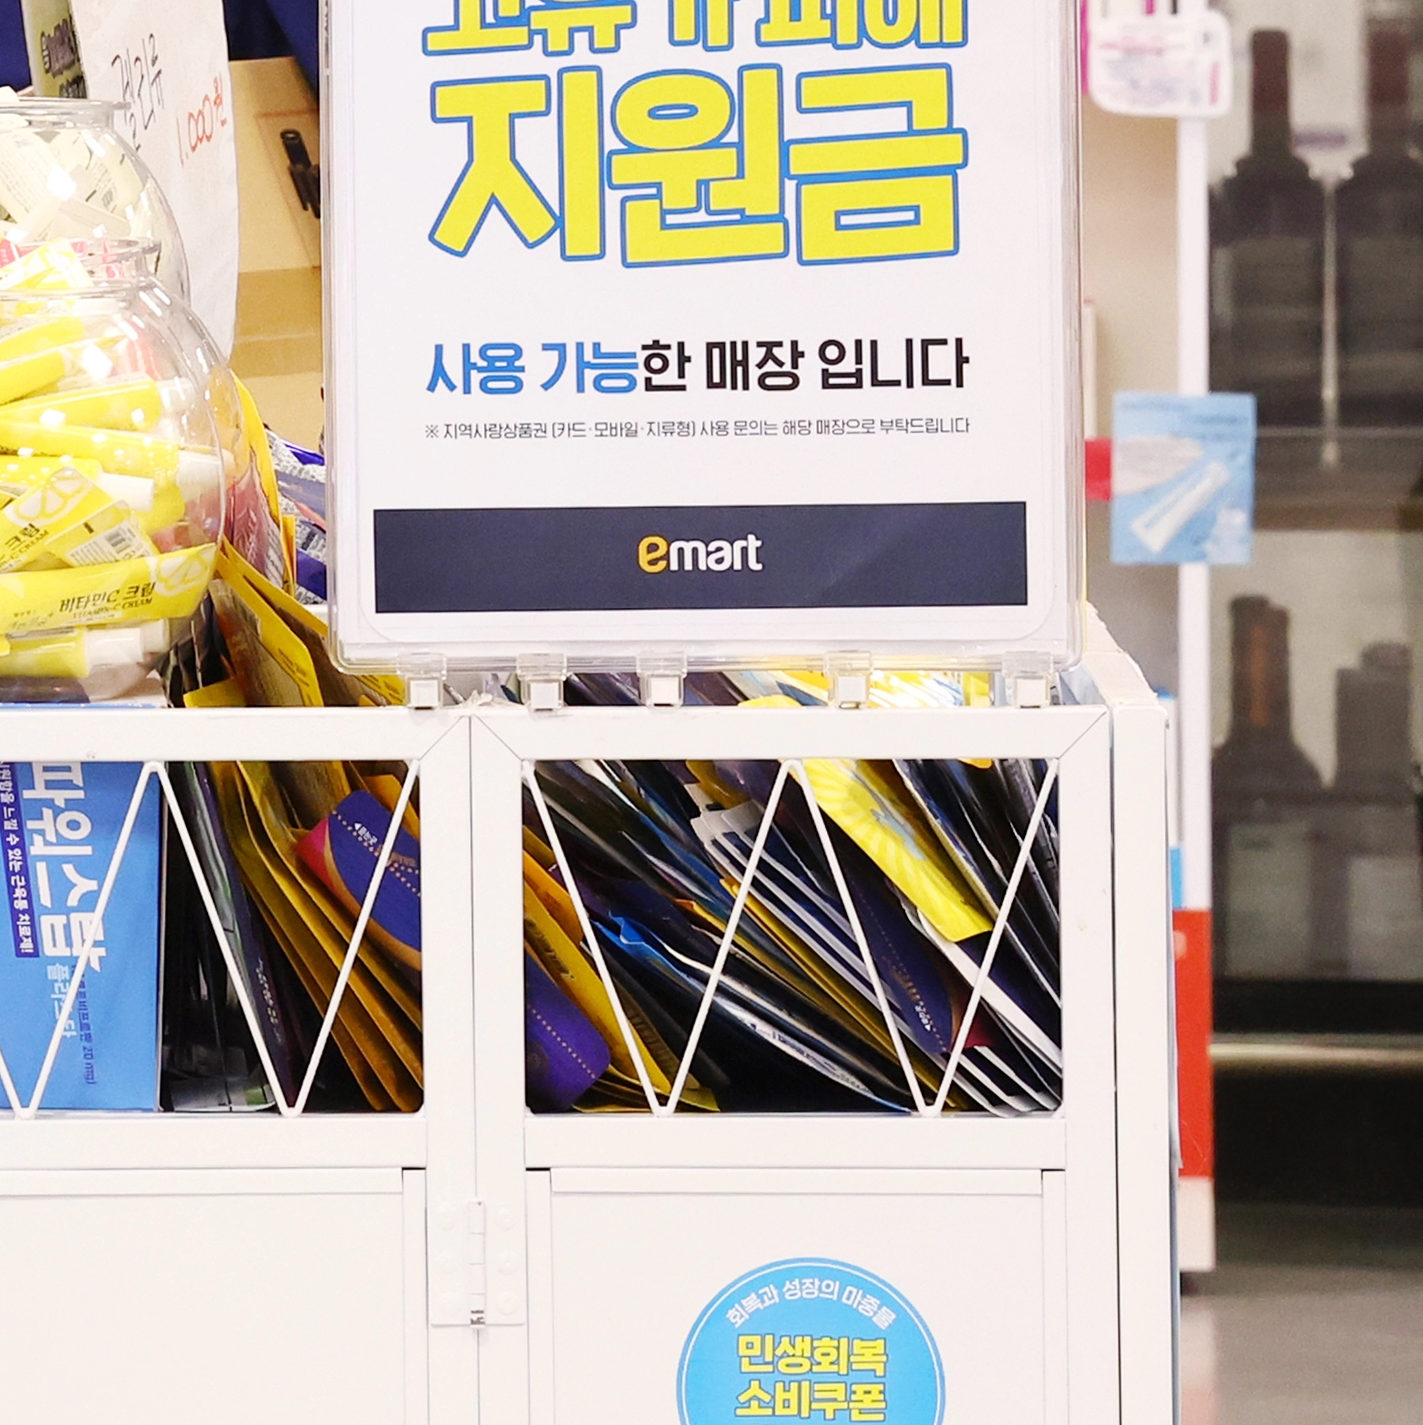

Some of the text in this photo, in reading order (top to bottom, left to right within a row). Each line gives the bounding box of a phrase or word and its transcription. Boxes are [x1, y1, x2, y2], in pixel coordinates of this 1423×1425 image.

[429, 63, 968, 268] 지원금
[426, 337, 970, 395] 사용 가능한 매장 입니다
[444, 422, 548, 440] 지역사랑상품권
[700, 420, 730, 437] 사용
[734, 419, 779, 437] 문의는
[782, 418, 812, 436] 해당
[816, 418, 876, 435] 매장으로
[879, 416, 970, 435] 부탁드립니다
[636, 533, 765, 574] emart
[59, 589, 120, 614] 비타민C
[7, 833, 21, 846] 수
[7, 848, 23, 872] 있는
[725, 1278, 897, 1330] 회복과 성장의 마중물
[736, 1334, 888, 1377] 민생회복
[734, 1379, 887, 1422] 소비쿠폰
